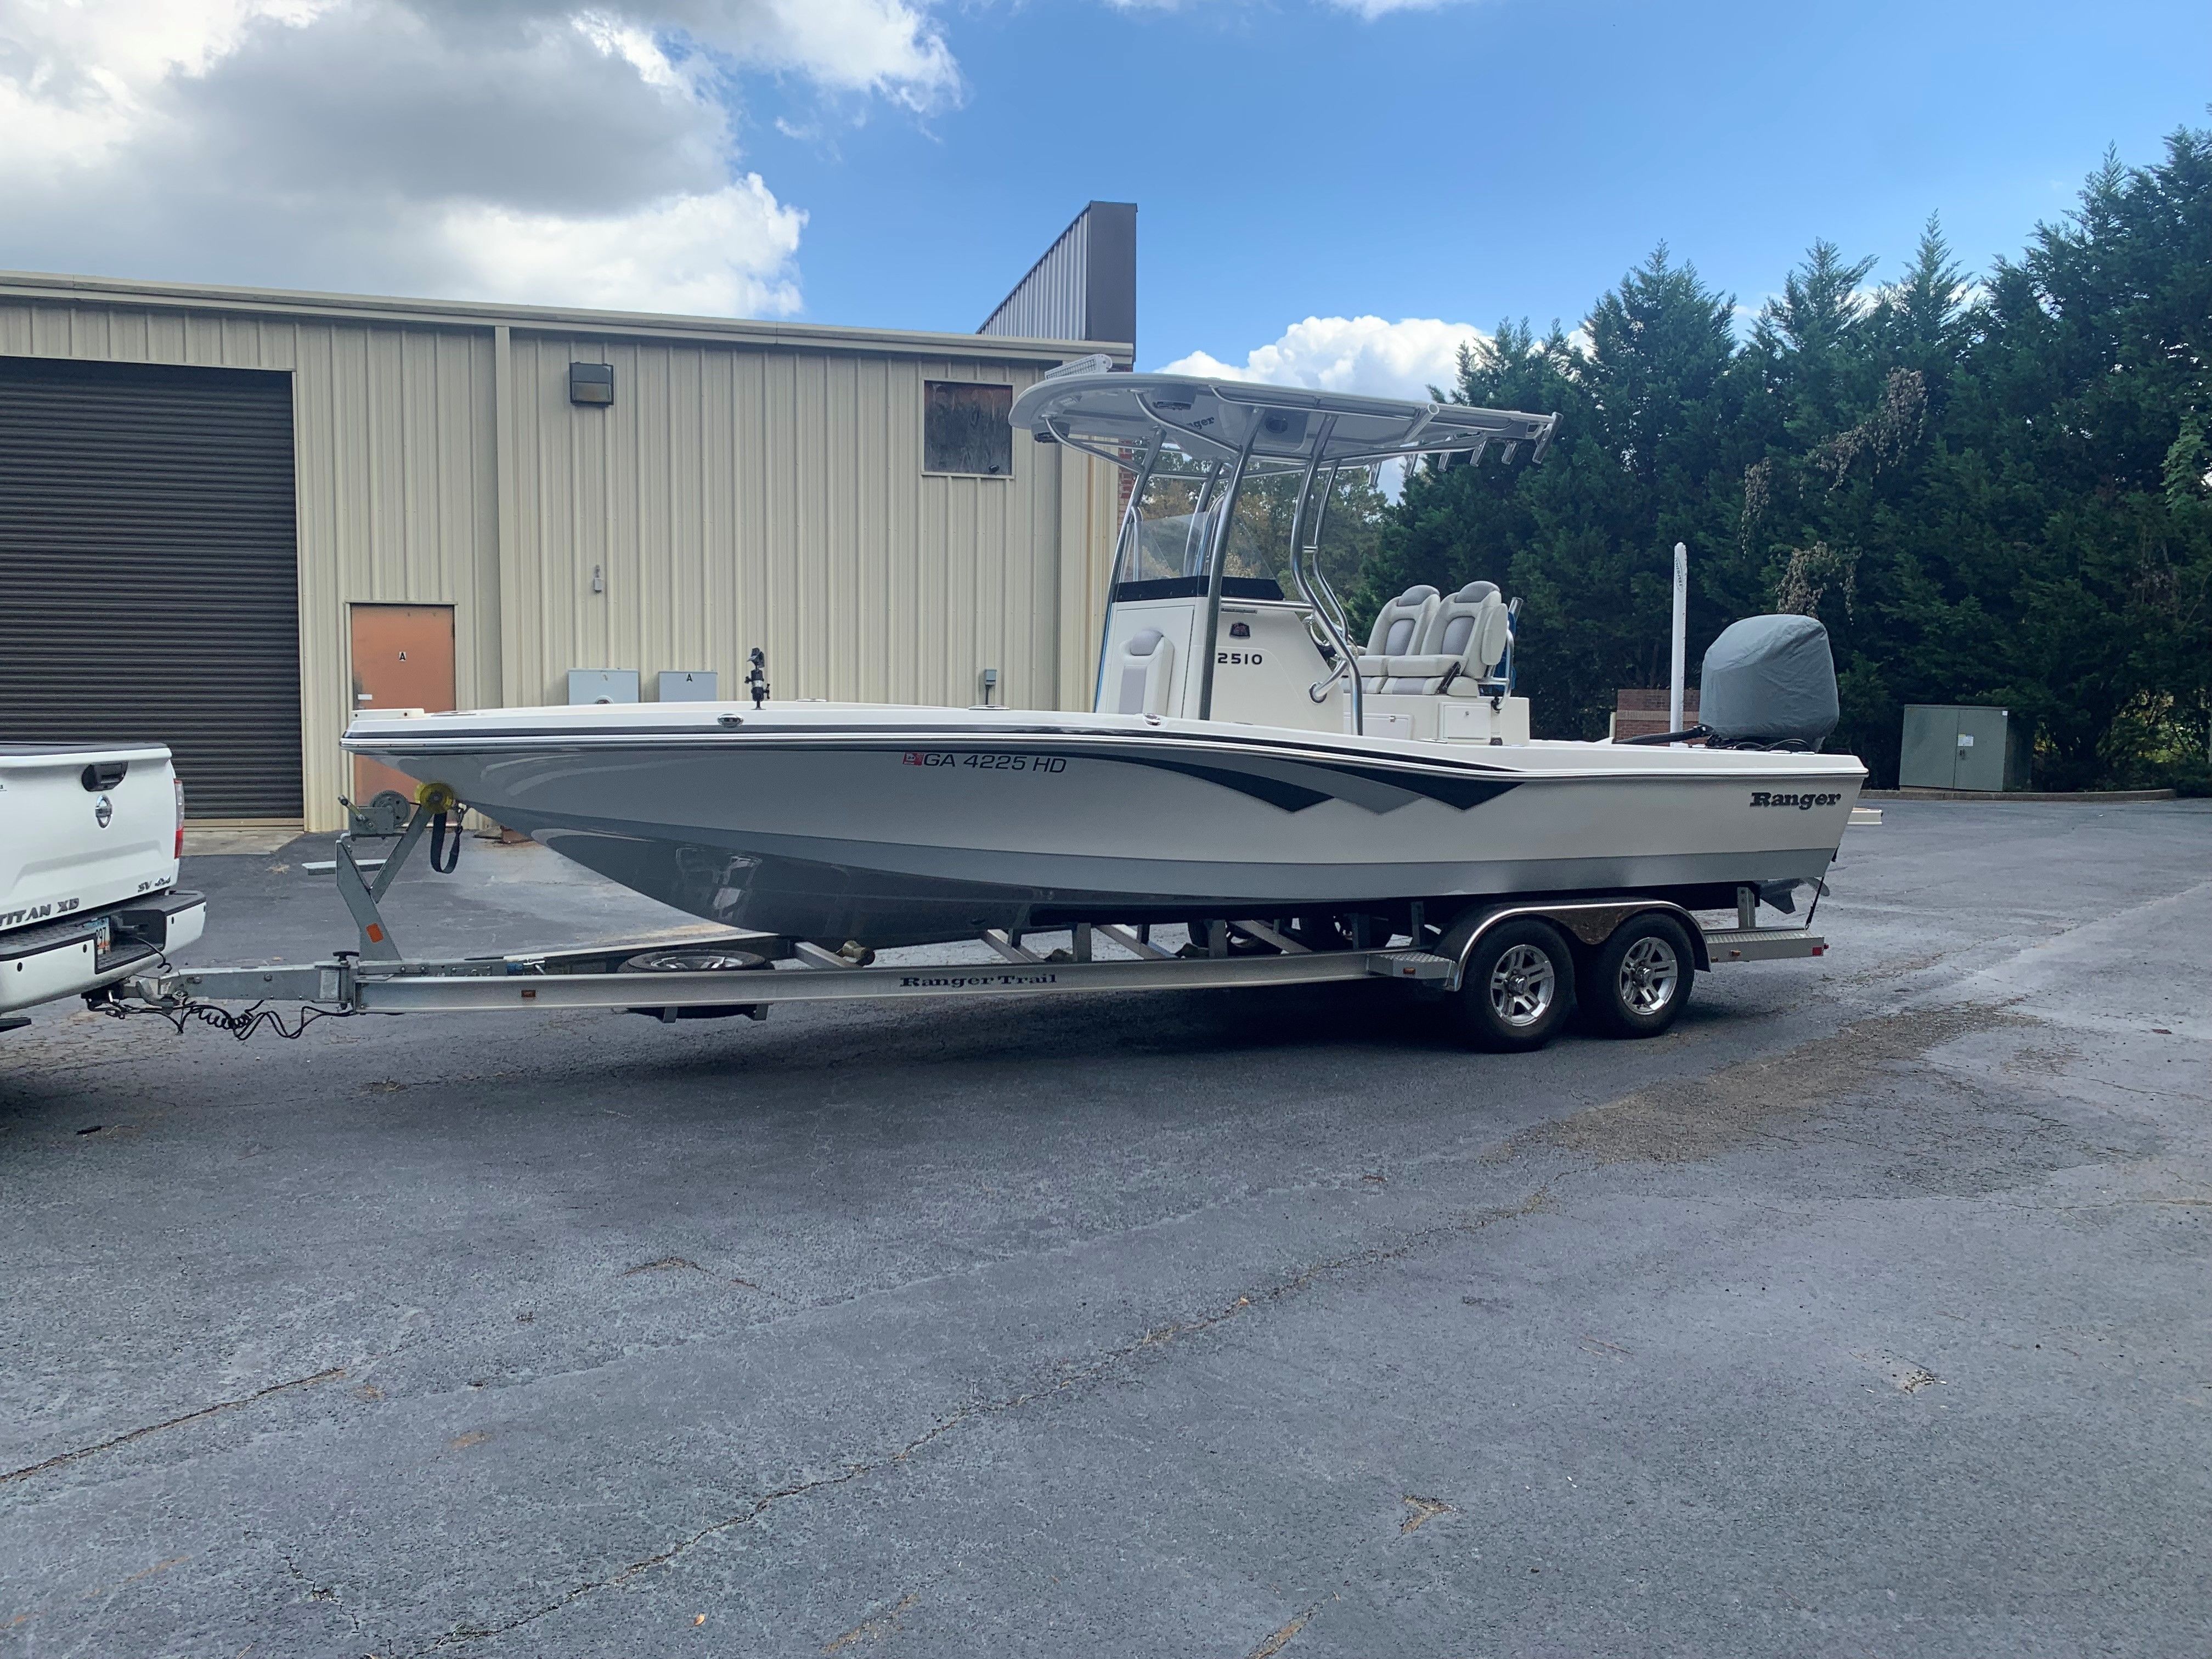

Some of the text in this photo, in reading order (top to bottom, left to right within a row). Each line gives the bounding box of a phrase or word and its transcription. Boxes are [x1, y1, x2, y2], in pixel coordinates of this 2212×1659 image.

[399, 652, 406, 661] A
[1217, 652, 1262, 665] 2510
[686, 674, 693, 682] A
[924, 753, 1067, 774] GA 4225 HD
[1750, 792, 1841, 810] Ranger
[56, 898, 80, 913] XD
[900, 974, 1057, 988] Ranger Trail
